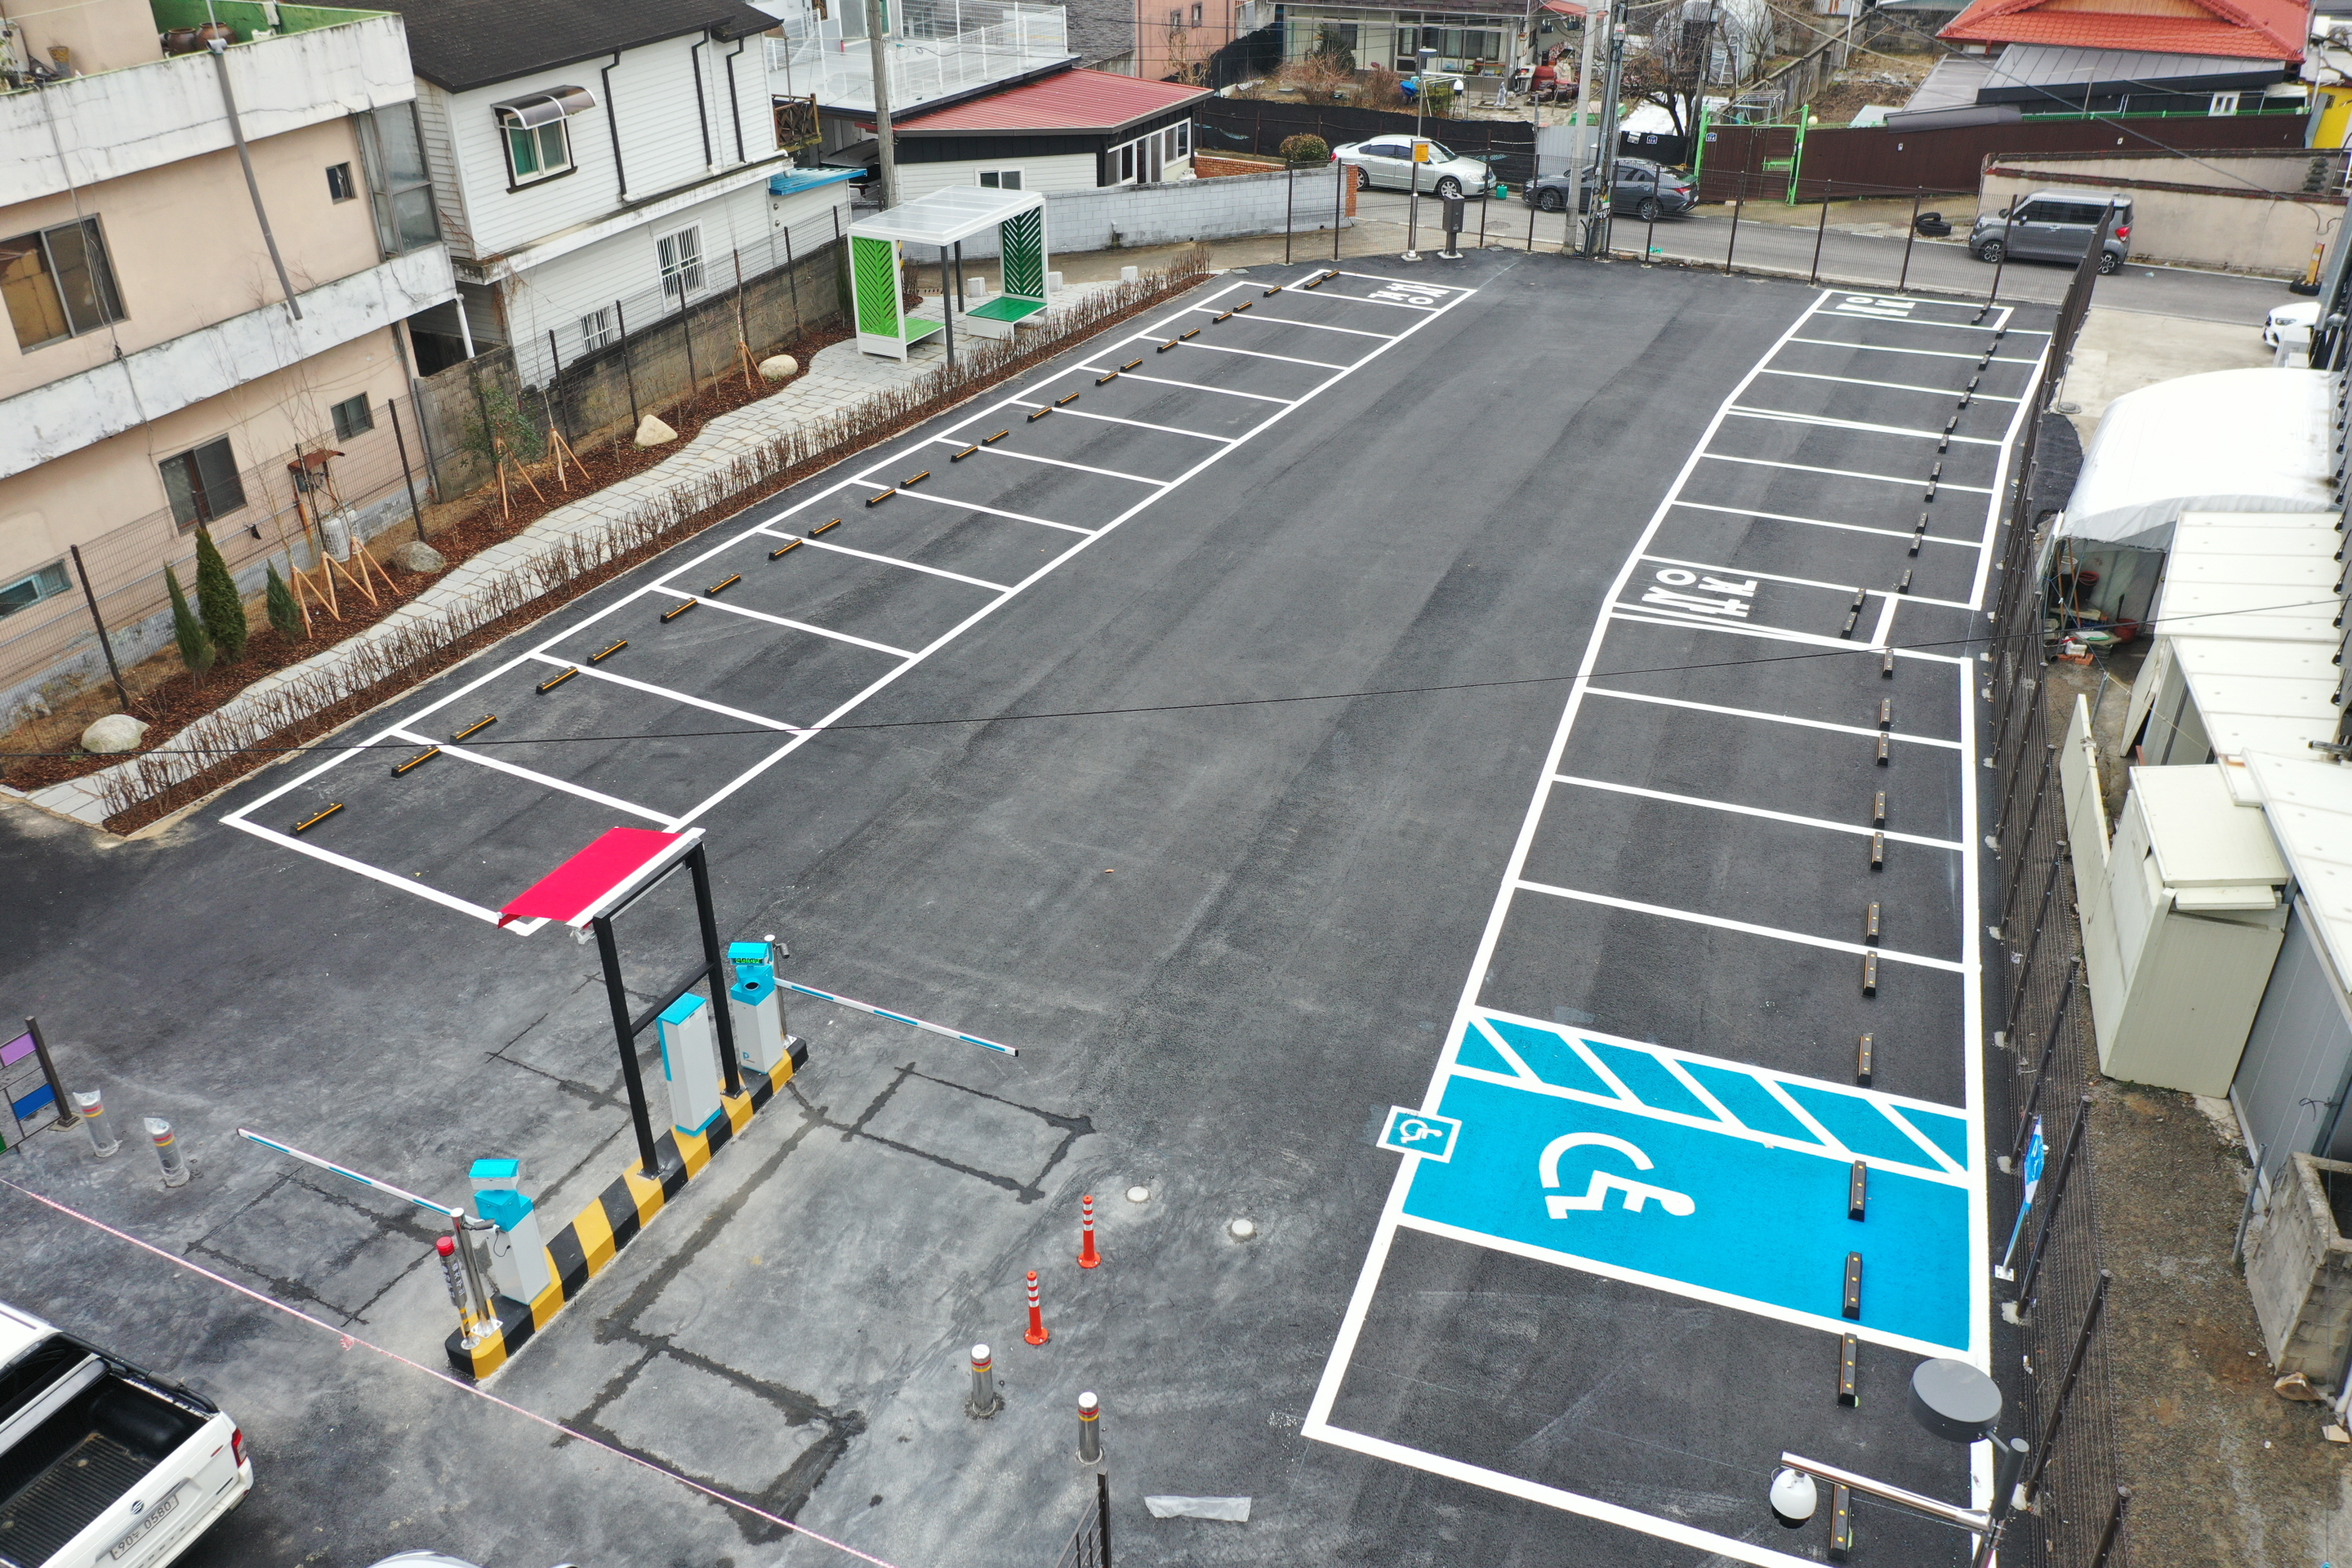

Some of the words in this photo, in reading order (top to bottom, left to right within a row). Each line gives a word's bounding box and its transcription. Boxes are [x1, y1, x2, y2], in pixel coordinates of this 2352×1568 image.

[1367, 282, 1450, 305] 경차
[1835, 296, 1916, 317] 경차
[1642, 568, 1758, 618] 경차
[118, 1530, 140, 1552] 90누
[143, 1501, 172, 1530] 0580
